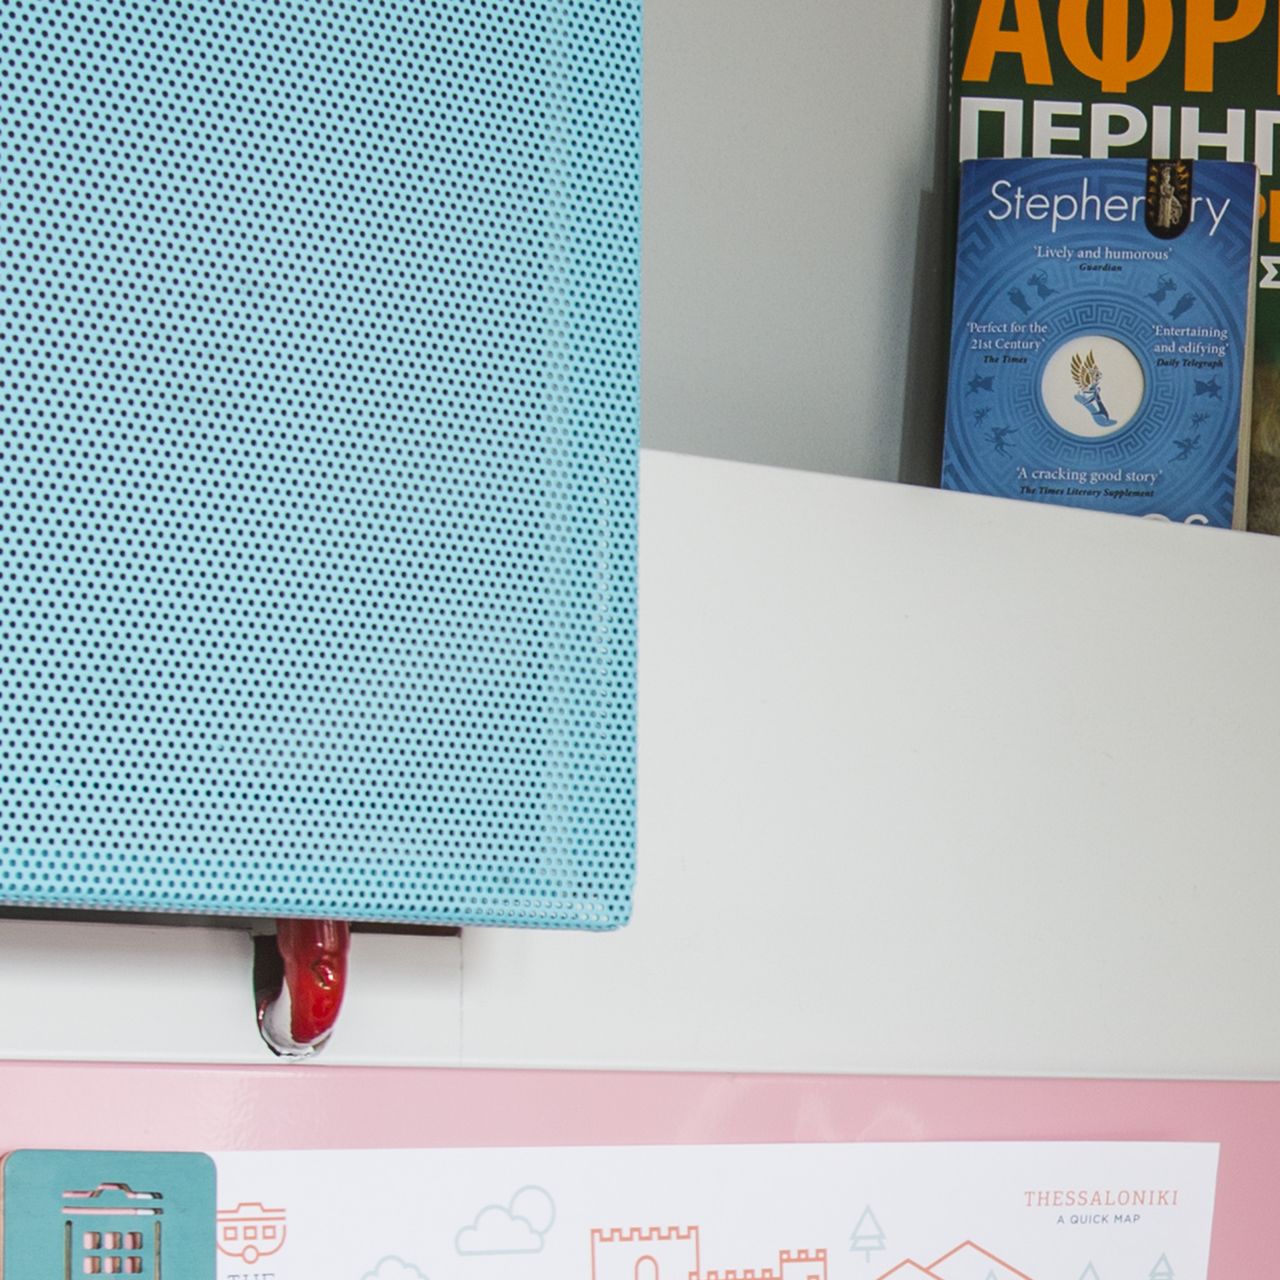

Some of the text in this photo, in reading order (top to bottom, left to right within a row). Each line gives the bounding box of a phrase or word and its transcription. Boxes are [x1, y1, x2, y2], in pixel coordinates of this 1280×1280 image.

[1077, 247, 1101, 259] and
[1079, 263, 1123, 272] Guardian
[1010, 322, 1027, 333] for
[1029, 322, 1047, 333] the
[971, 338, 993, 350] 21st
[1153, 341, 1176, 353] and
[984, 355, 1027, 364] The Times
[1156, 357, 1223, 368] Daily Telegraph
[1031, 467, 1087, 484] cracking
[1089, 468, 1123, 485] good
[1020, 485, 1154, 498] The Times Literary Supplement
[1024, 1190, 1179, 1207] THESSALONIKI
[1057, 1214, 1141, 1225] A QUICK MAP
